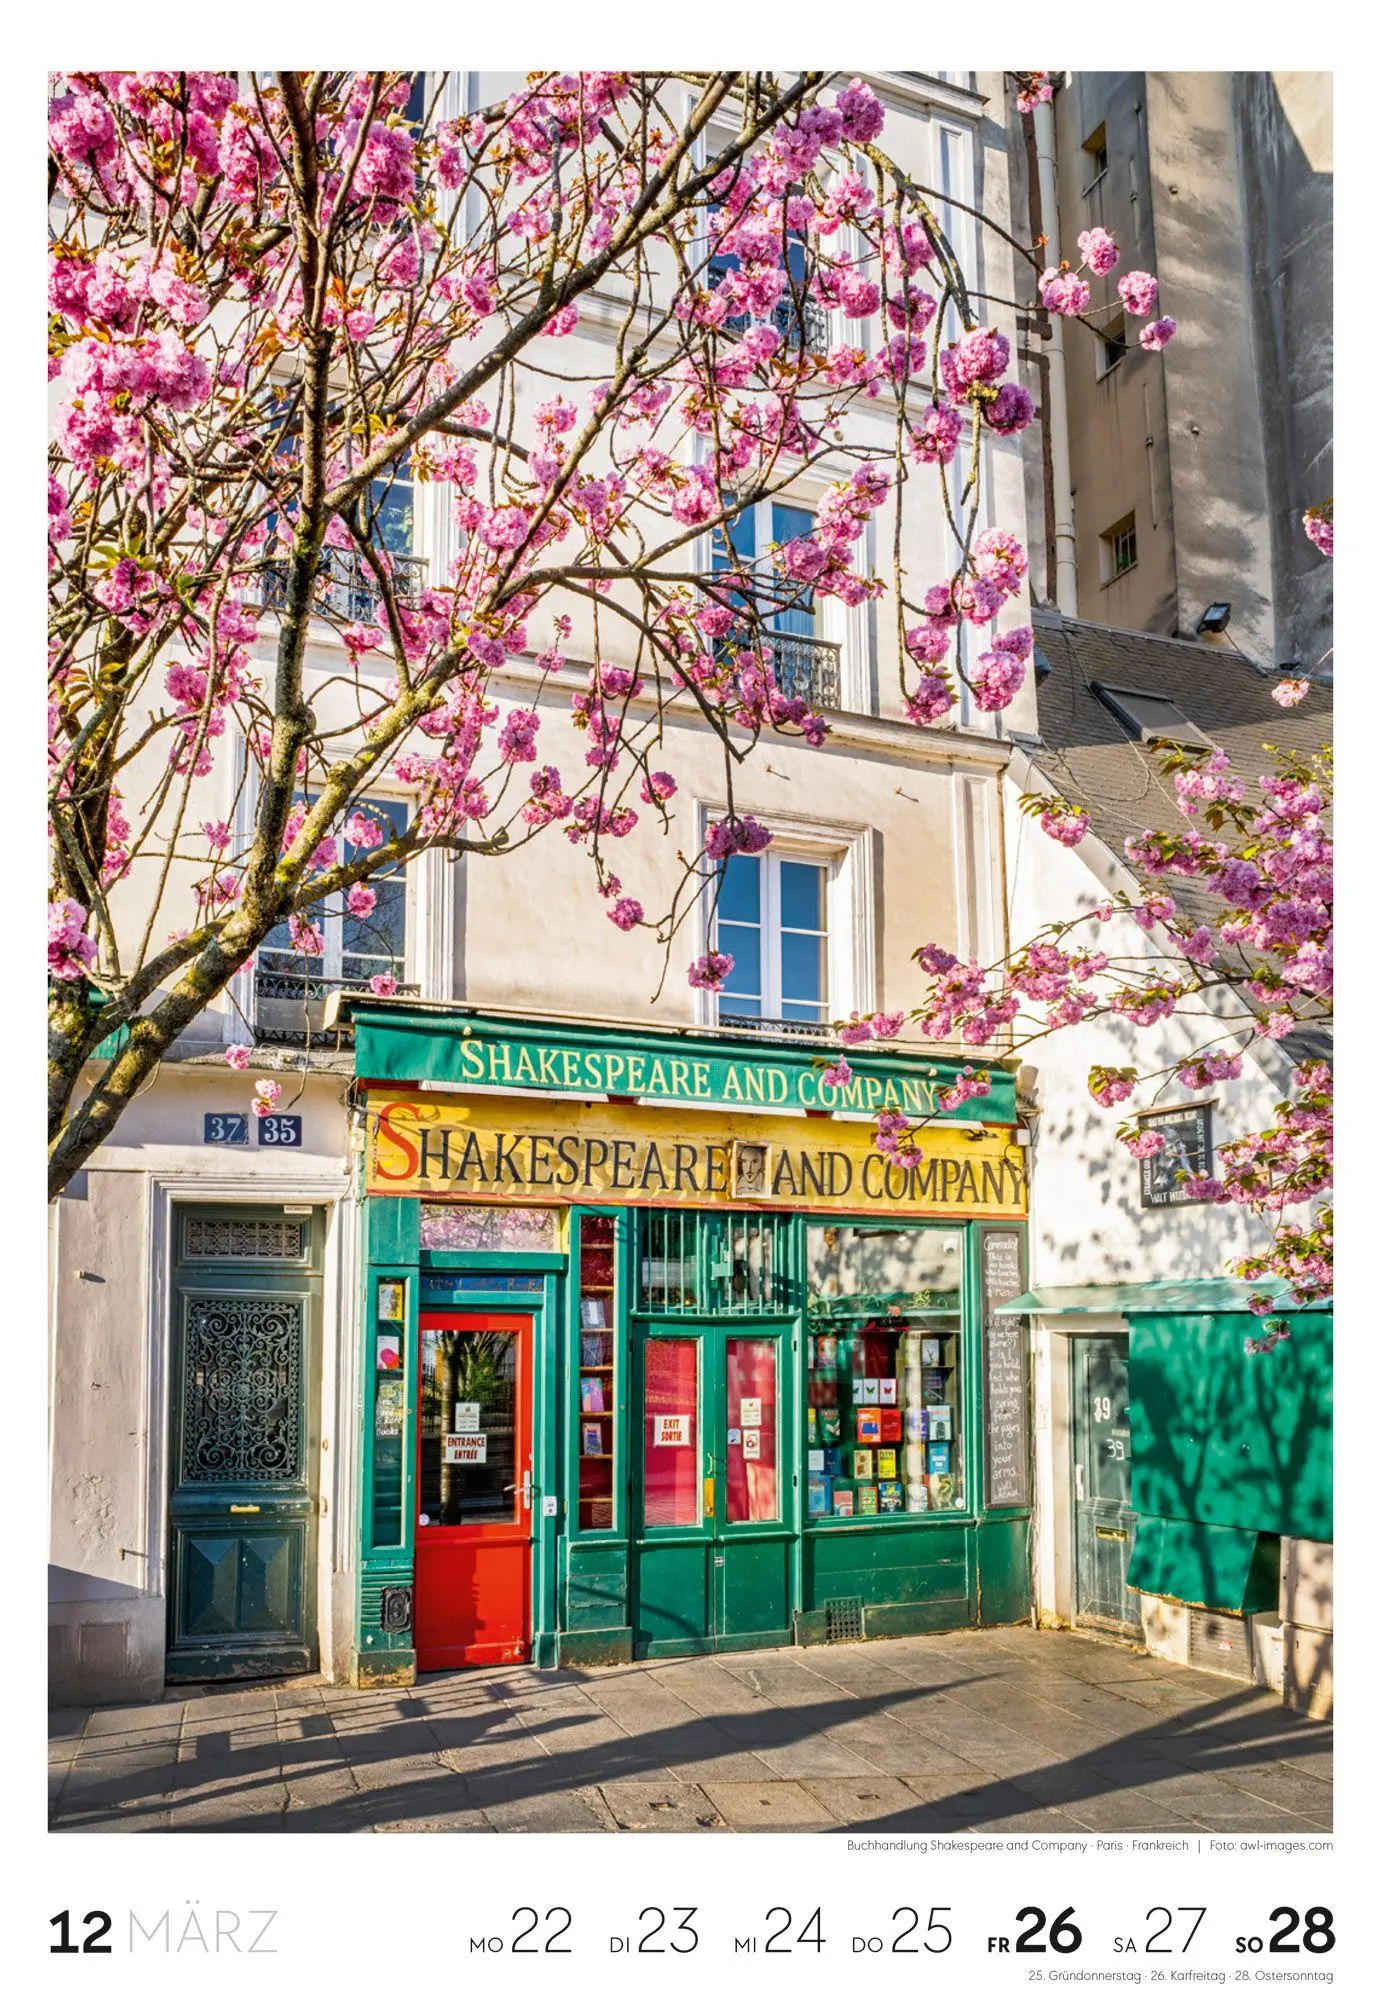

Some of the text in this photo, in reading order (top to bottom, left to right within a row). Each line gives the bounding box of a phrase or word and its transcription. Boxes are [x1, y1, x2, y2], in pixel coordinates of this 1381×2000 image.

[460, 1038, 937, 1113] SHAKESPEARE AND COMPANY
[211, 1117, 242, 1142] 37
[264, 1117, 297, 1144] 35
[376, 1101, 1027, 1205] SHAKESPEARE AND COMPANY
[663, 1418, 680, 1430] EXIT
[447, 1436, 485, 1448] ENTRANCE
[661, 1431, 683, 1442] SORTIE
[1106, 1438, 1124, 1460] 39
[992, 1454, 1013, 1469] your
